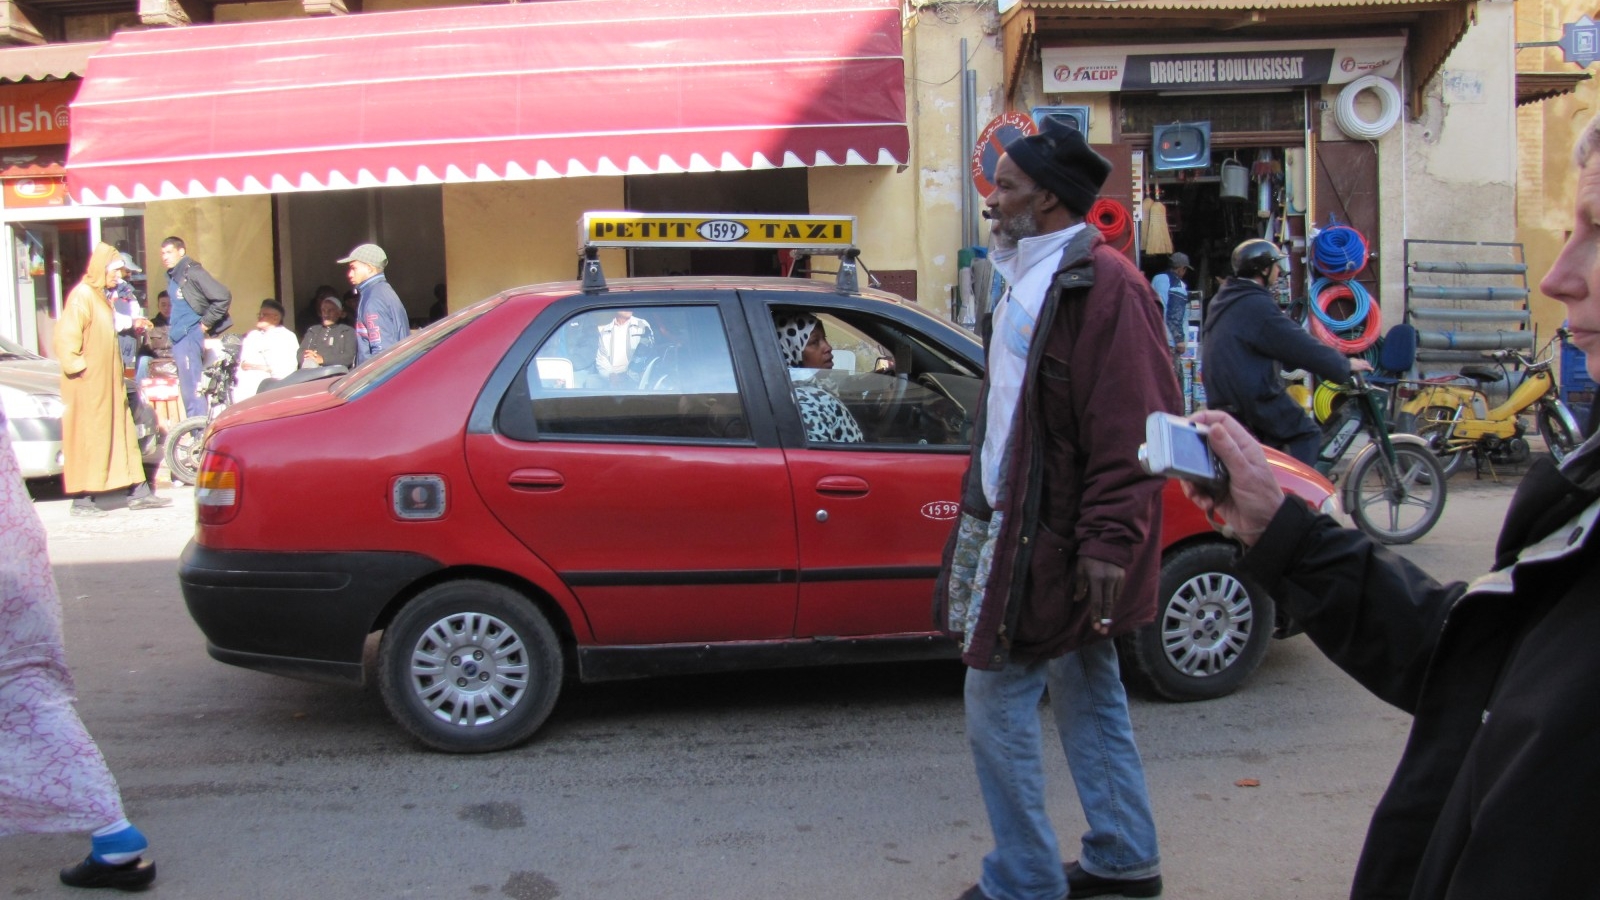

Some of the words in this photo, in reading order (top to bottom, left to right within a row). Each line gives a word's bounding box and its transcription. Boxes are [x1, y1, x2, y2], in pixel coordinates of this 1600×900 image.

[1150, 60, 1216, 84] DROGUERIE
[1217, 57, 1304, 82] BOULKHSISSAT
[595, 222, 692, 238] PETIT
[708, 223, 738, 239] 1599
[760, 223, 842, 239] TAXI
[929, 504, 957, 515] 1599
